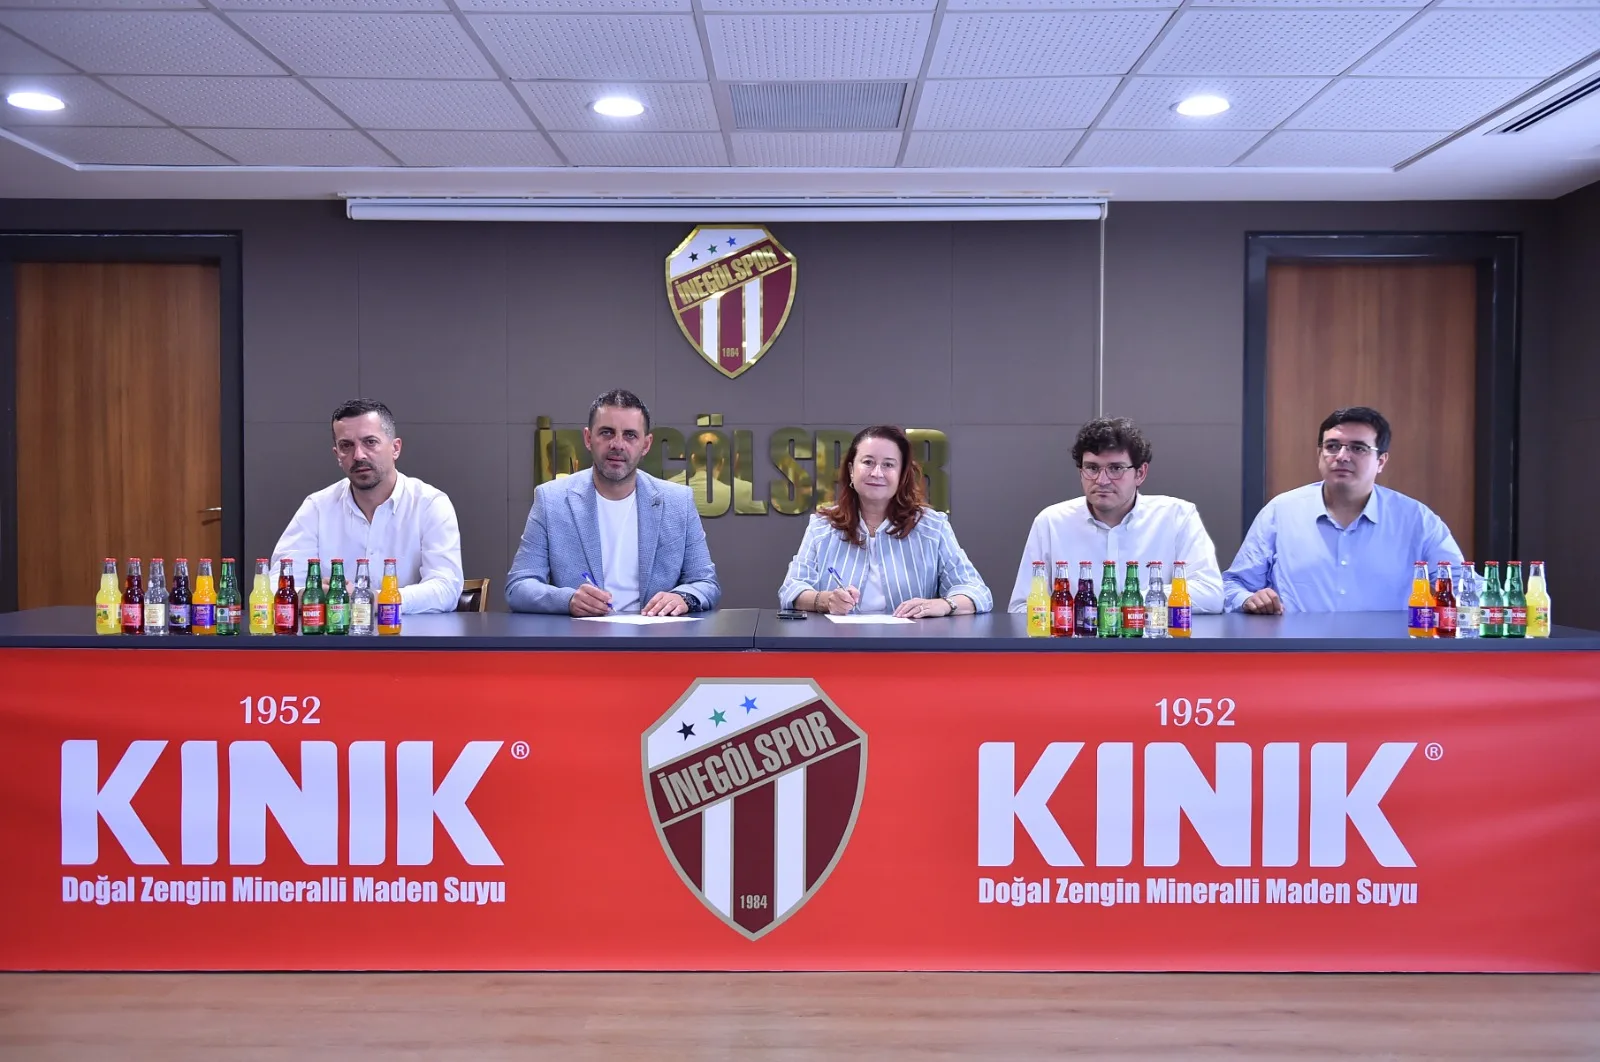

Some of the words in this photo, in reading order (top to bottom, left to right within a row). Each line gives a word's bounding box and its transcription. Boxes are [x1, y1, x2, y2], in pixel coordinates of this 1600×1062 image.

[675, 245, 779, 305] İNEGÖLSPOR
[533, 414, 950, 517] İNGÖLSPR
[241, 696, 321, 725] 1952
[1155, 698, 1236, 727] 1952
[657, 711, 836, 814] İNEGÖLSPOR
[61, 740, 504, 866] KINIK
[978, 742, 1418, 868] KINIK
[62, 876, 135, 904] Doğal
[141, 877, 226, 906] Zengin
[232, 877, 347, 903] Mineralli
[353, 878, 438, 903] Maden
[444, 877, 506, 905] Suyu
[740, 895, 768, 909] 1984
[979, 877, 1049, 906] Doğal
[1056, 878, 1139, 907] Zengin
[1147, 879, 1259, 903] Mineralli
[1267, 879, 1350, 904] Maden
[1357, 879, 1418, 906] Suyu
